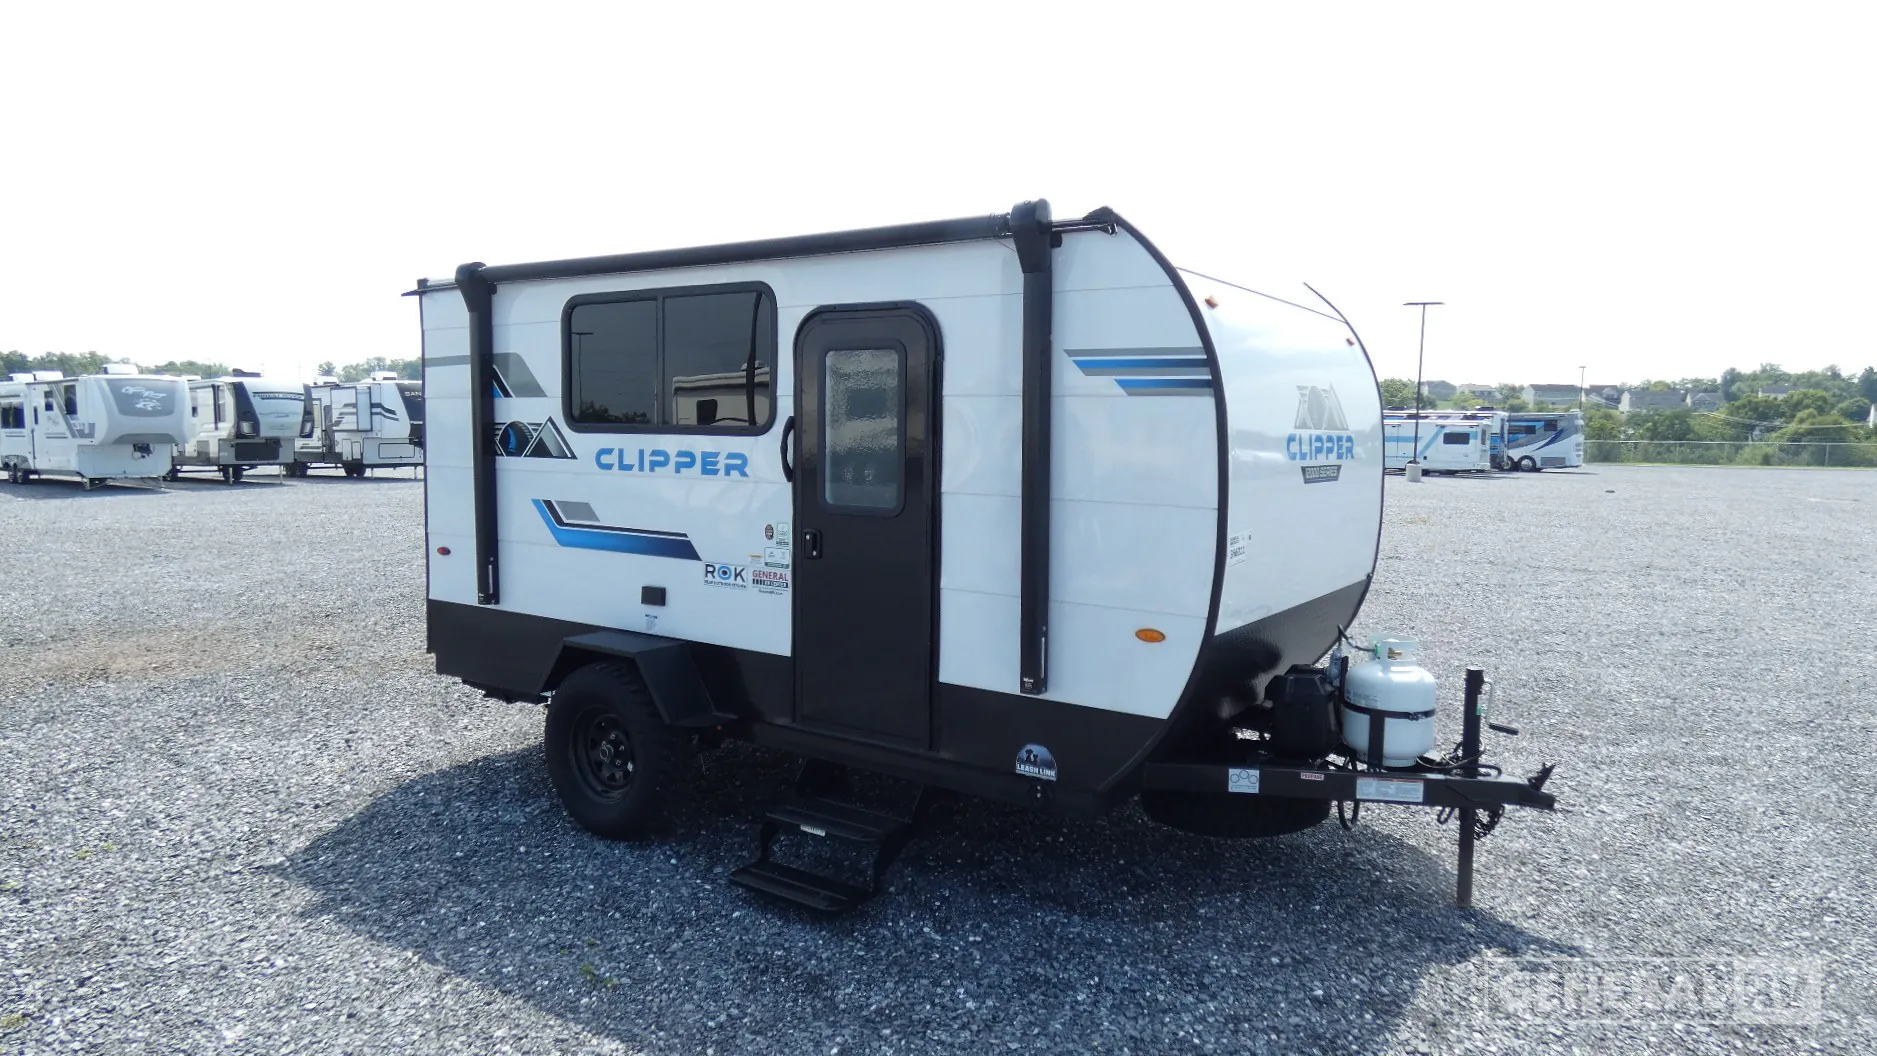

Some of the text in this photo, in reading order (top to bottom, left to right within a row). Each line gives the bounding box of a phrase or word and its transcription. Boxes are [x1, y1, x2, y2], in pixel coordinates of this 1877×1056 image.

[1286, 433, 1354, 460] CLIPPER
[595, 447, 749, 477] CLIPPER
[704, 563, 746, 583] ROK
[752, 570, 788, 581] GENERAL
[1017, 763, 1056, 777] LEASH LINK
